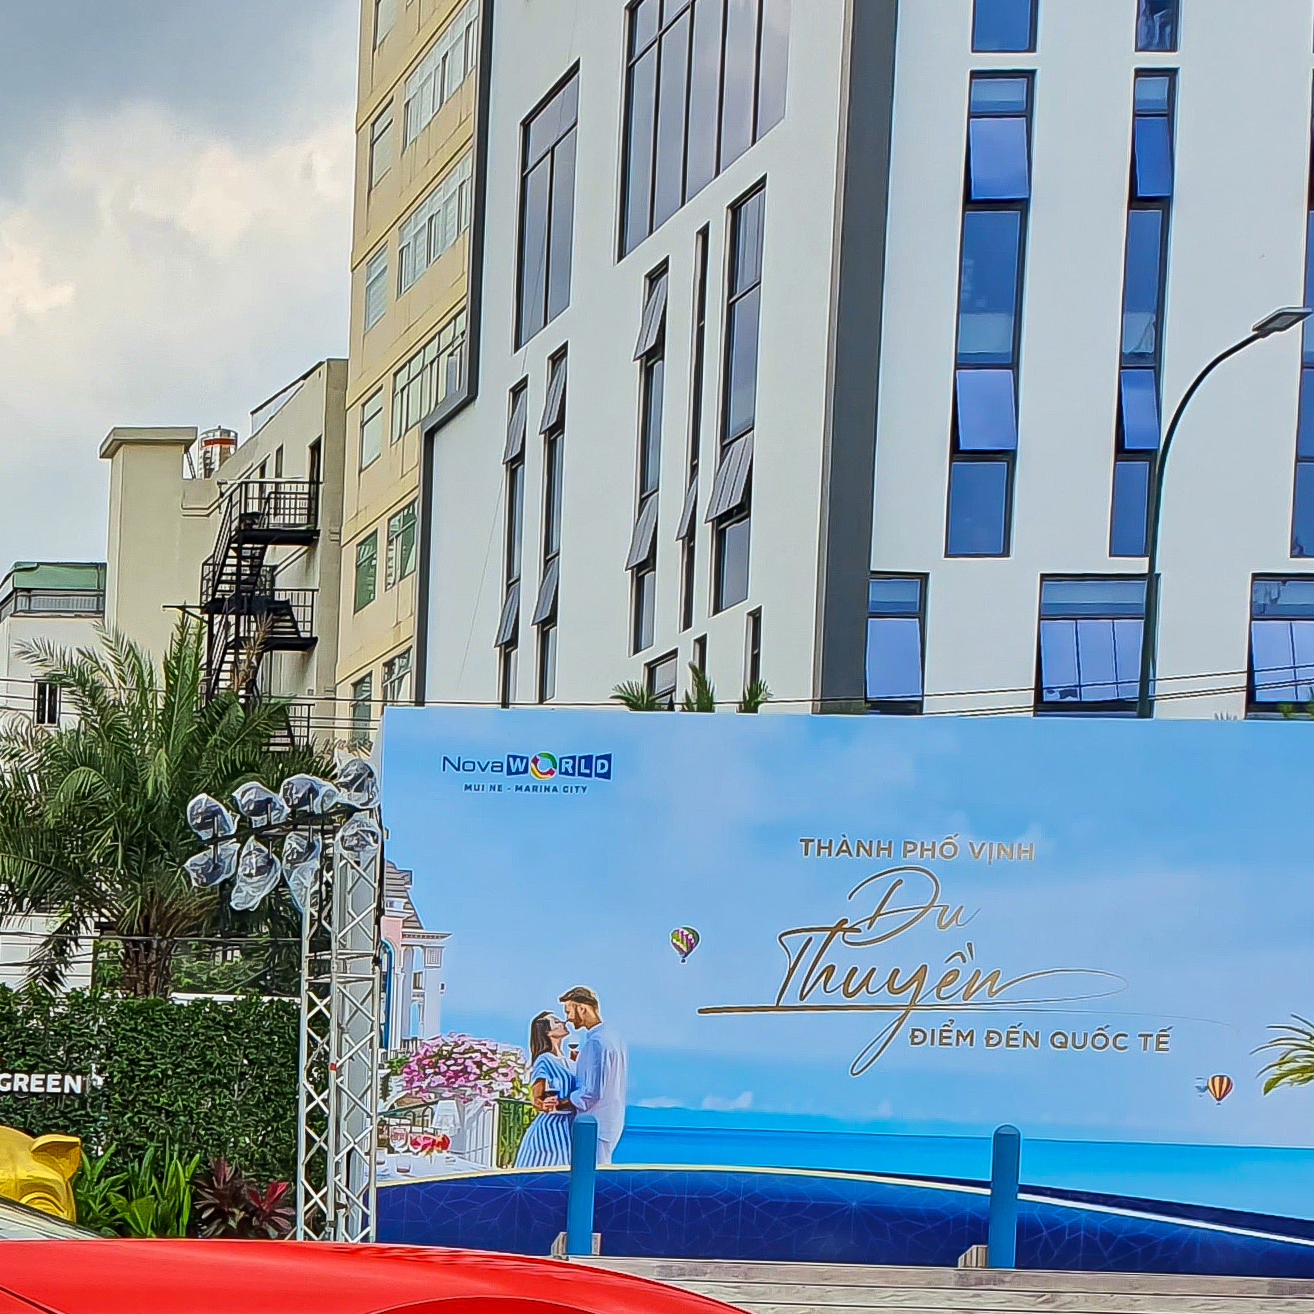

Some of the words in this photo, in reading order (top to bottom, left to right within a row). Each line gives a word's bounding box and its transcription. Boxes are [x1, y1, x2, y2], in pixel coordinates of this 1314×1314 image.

[464, 784, 485, 792] MUI
[490, 784, 503, 792] NE
[563, 785, 588, 794] CITY
[800, 836, 893, 860] THÀNH
[902, 833, 960, 860] PHỐ
[969, 842, 1035, 865] VỊNH
[843, 866, 981, 946] Du
[776, 919, 1128, 1077] Thuyền
[909, 1020, 975, 1048] ĐIỂM
[985, 1022, 1040, 1049] ĐẾN
[1050, 1024, 1129, 1052] QUỐC
[1138, 1026, 1174, 1052] TẾ
